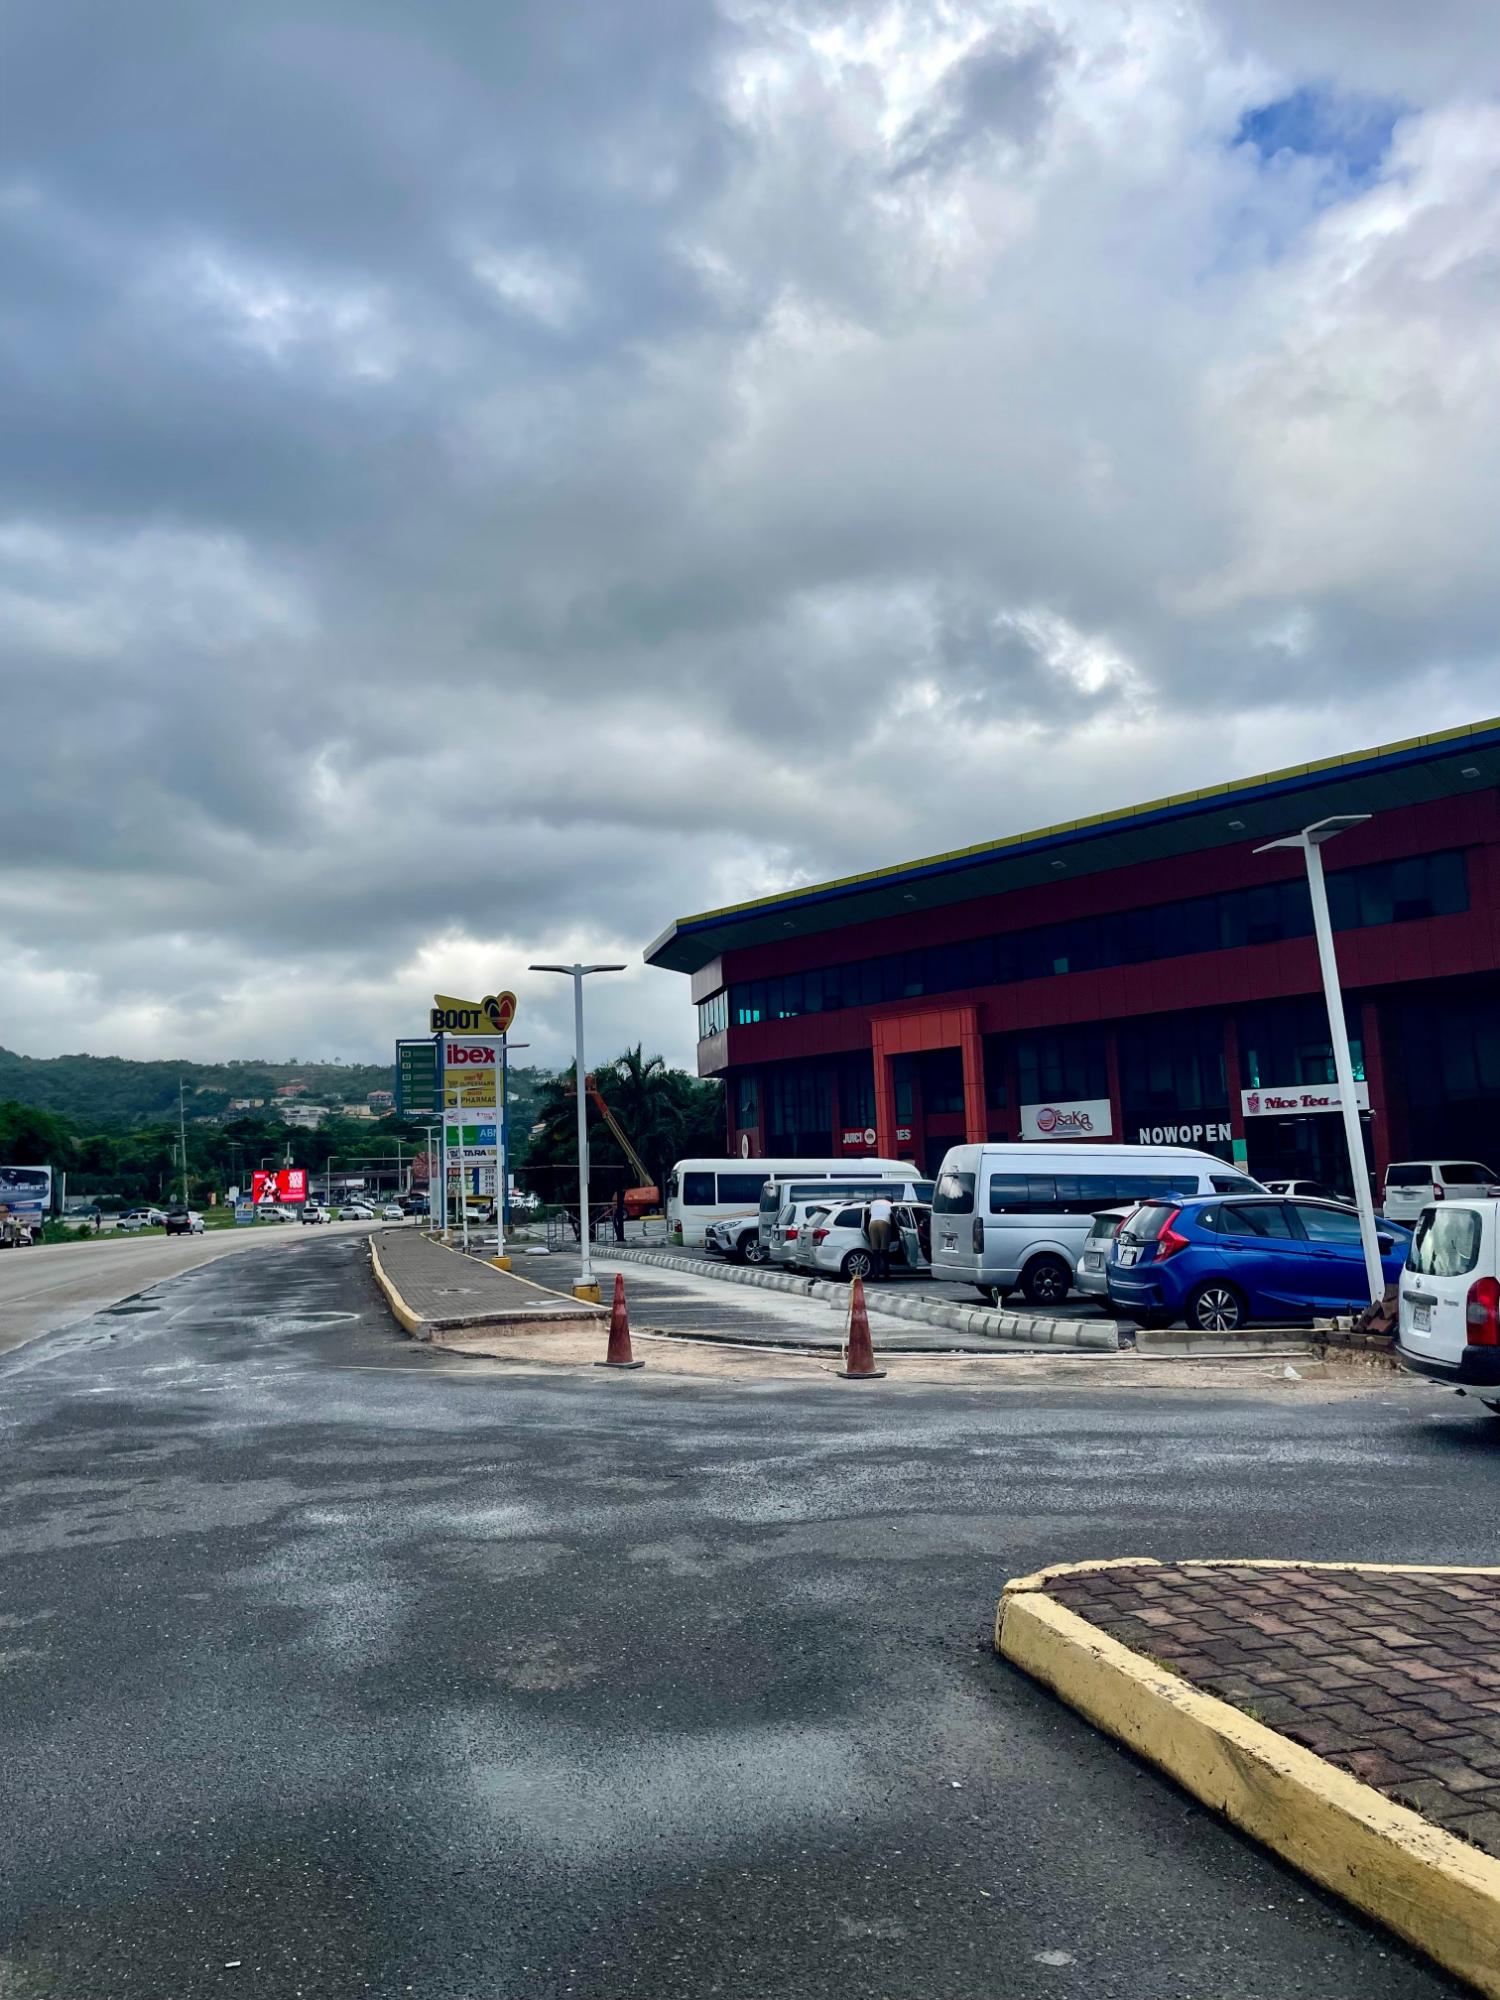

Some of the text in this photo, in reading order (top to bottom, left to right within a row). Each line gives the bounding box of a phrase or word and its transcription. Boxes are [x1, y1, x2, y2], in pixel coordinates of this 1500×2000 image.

[432, 1009, 482, 1030] BOOT
[447, 1044, 496, 1065] ibex
[1265, 1097, 1298, 1109] Nice
[1300, 1094, 1330, 1107] Tea
